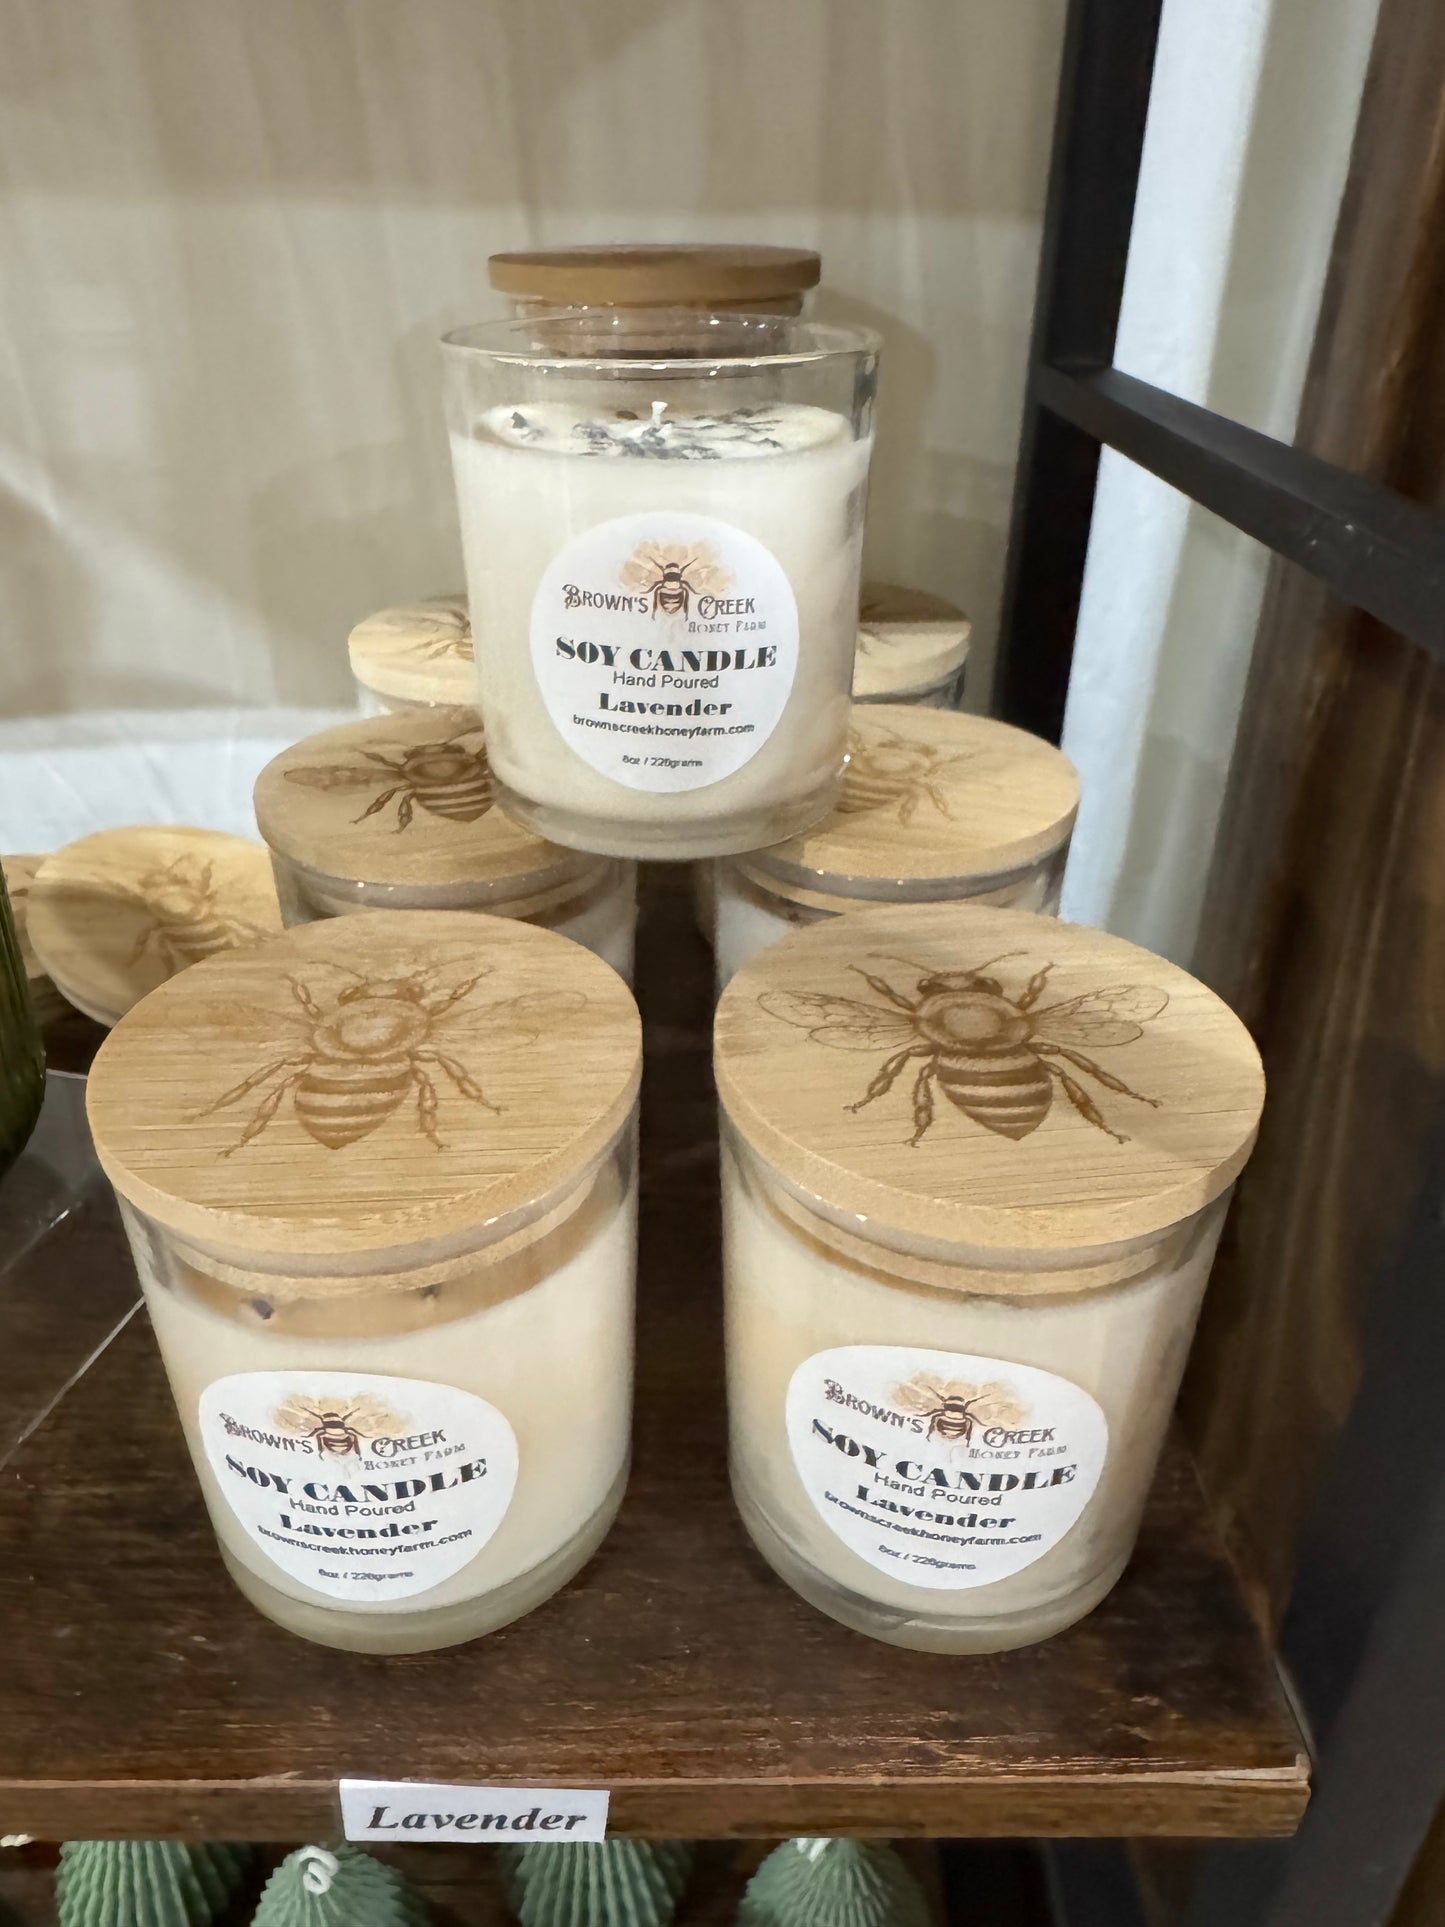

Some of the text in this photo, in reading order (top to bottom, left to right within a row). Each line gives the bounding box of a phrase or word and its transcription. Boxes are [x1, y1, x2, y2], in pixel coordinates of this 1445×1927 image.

[562, 584, 755, 619] BROWN'S CREEK
[556, 636, 777, 672] SOY CANDLE
[613, 671, 719, 688] Hand Poured
[598, 692, 732, 716] Lavender
[573, 714, 754, 739] brownscreekhoneyfarm.com
[823, 1379, 1056, 1448] BROWN'S CREEK
[219, 1412, 447, 1458] BROWN'S CREEK
[811, 1418, 1078, 1493] SOY CANDLE
[225, 1454, 487, 1502] SOY CANDLE
[874, 1472, 1002, 1506] Hand Poured
[289, 1498, 416, 1516] Hand Poured
[856, 1485, 1016, 1529] Lavender
[279, 1514, 439, 1539] Lavender
[366, 1805, 588, 1831] Lavender
